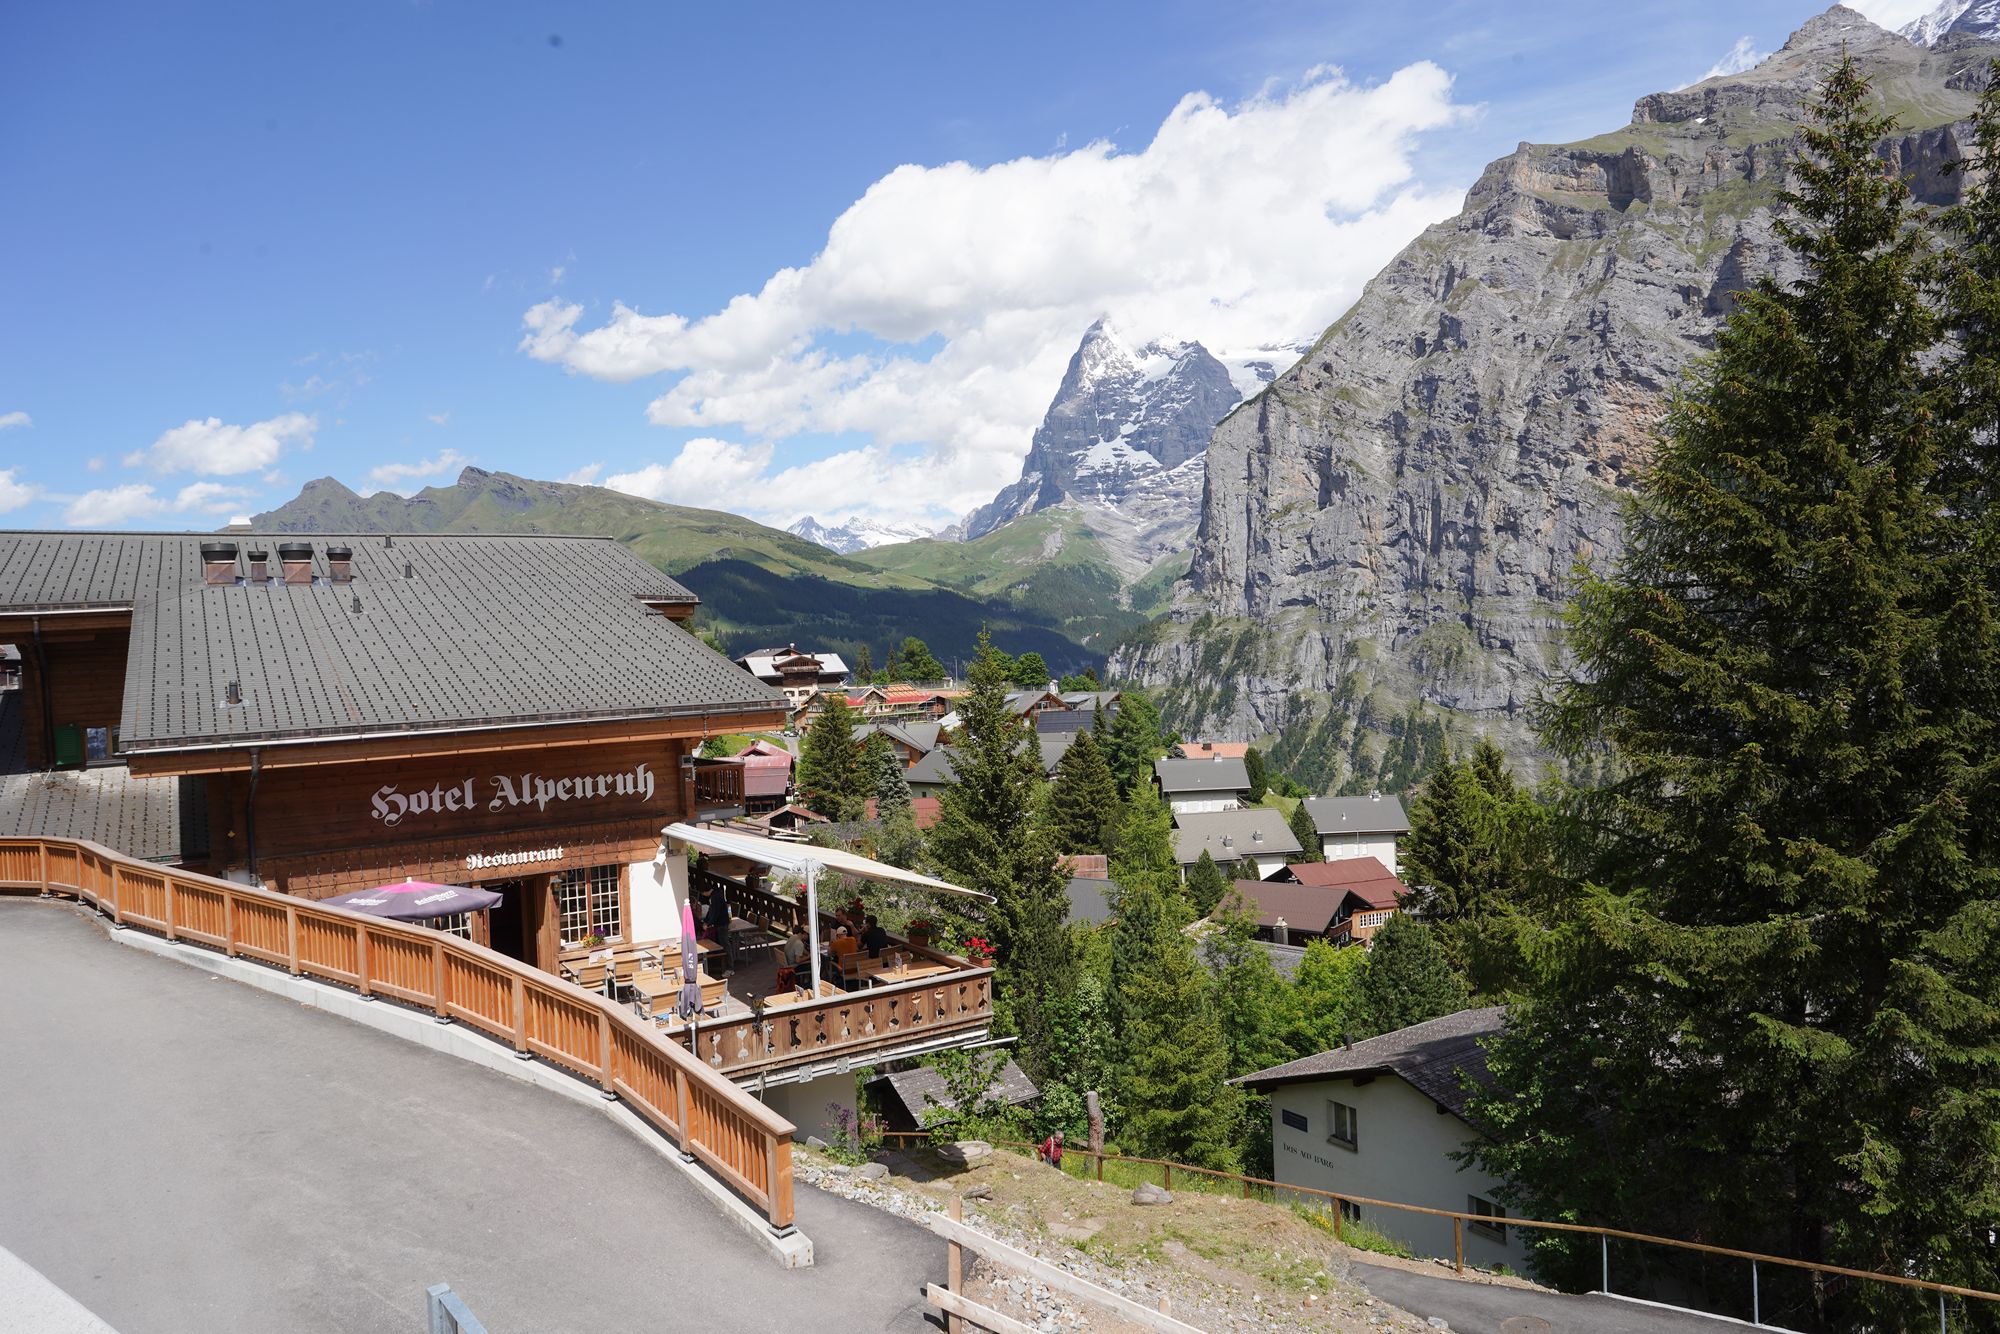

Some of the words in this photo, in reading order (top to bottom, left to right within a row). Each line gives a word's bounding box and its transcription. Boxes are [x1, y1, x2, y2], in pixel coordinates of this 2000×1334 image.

[371, 777, 478, 827] Hotel
[488, 762, 655, 812] Alpenruh
[465, 845, 564, 870] Restaurant
